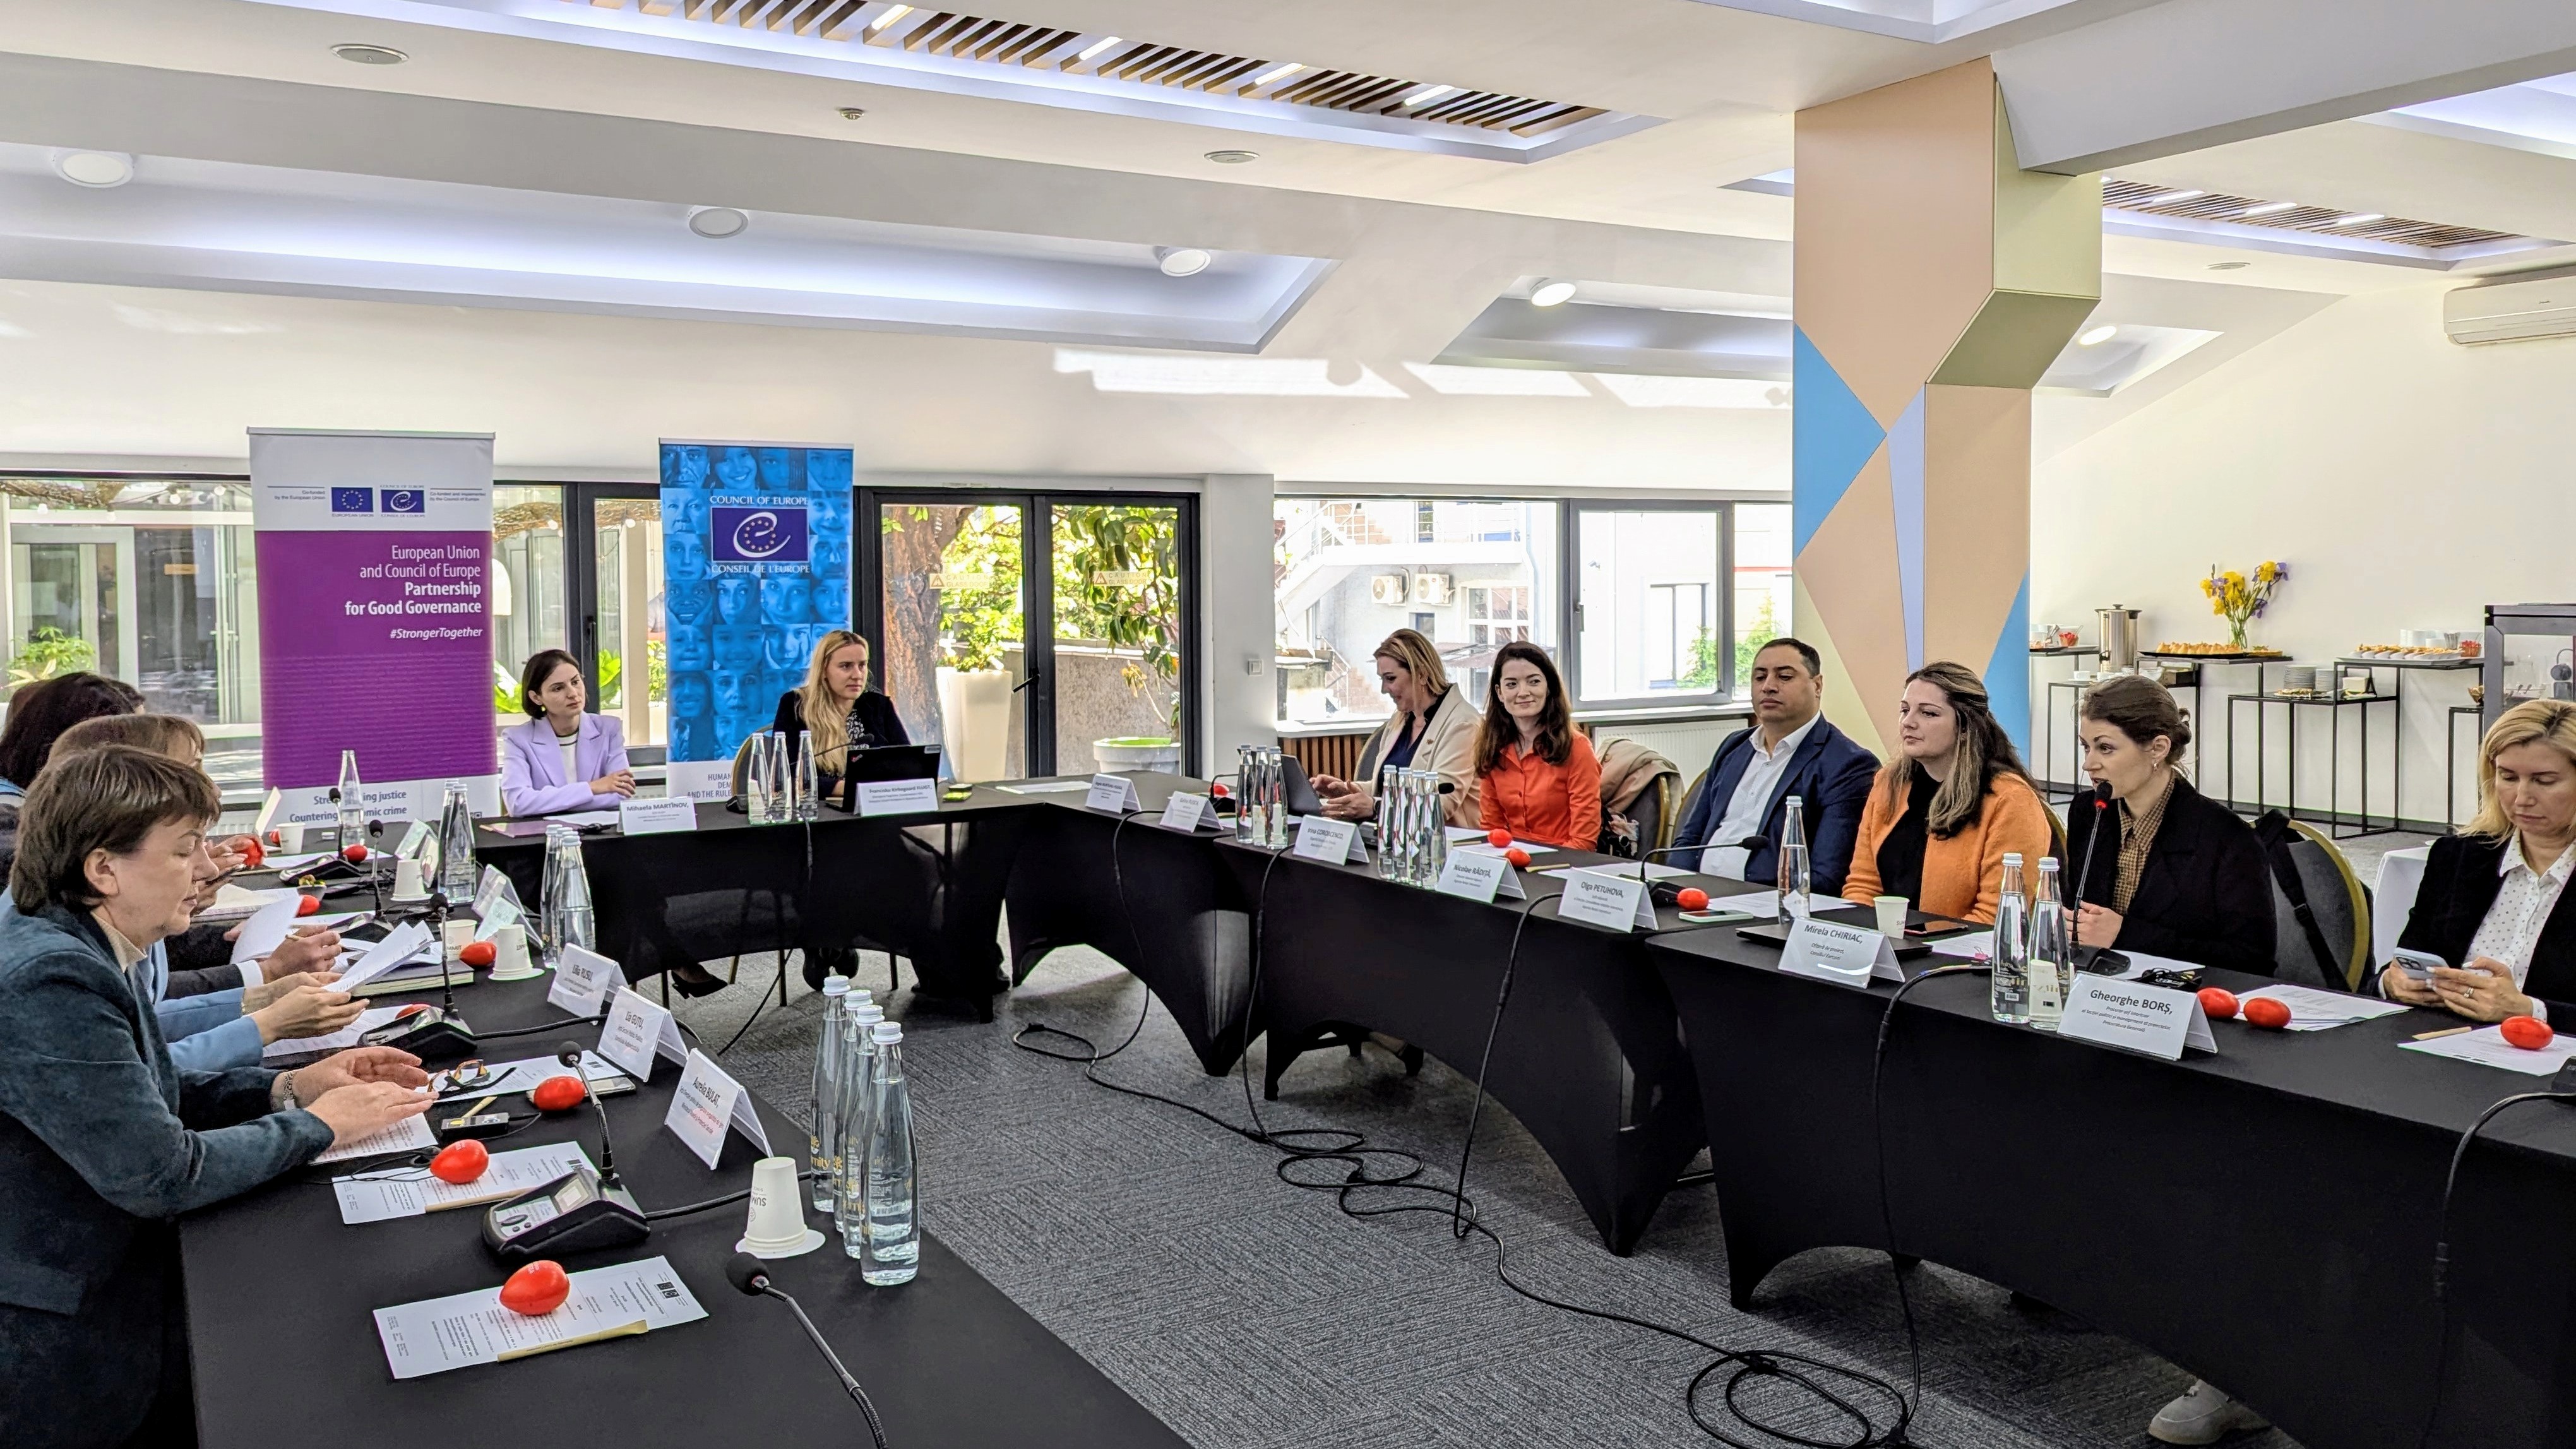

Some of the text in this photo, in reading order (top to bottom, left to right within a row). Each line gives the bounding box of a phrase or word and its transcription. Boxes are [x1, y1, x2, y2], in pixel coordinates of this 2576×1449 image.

[710, 495, 809, 505] COUNCIL OF EUROPE
[391, 545, 480, 562] European Union
[360, 563, 481, 580] and Council of Europe
[711, 564, 810, 573] CONSEIL DE L'EUROPE
[405, 581, 481, 599] Partnership
[345, 601, 482, 616] for Good Governance
[390, 627, 483, 641] #StrongerTogether
[379, 790, 407, 802] justice
[687, 790, 701, 799] AND
[701, 790, 714, 798] THE
[289, 811, 338, 823] Countering
[383, 806, 407, 816] crime
[626, 803, 652, 812] Mihaela
[1580, 880, 1624, 898] Olga PETUHOVA,
[1804, 924, 1863, 945] Mirela CHIRIAC,
[2090, 989, 2139, 1006] Gheorghe
[693, 1076, 707, 1096] Aurelia
[705, 1087, 720, 1108] BULAT,
